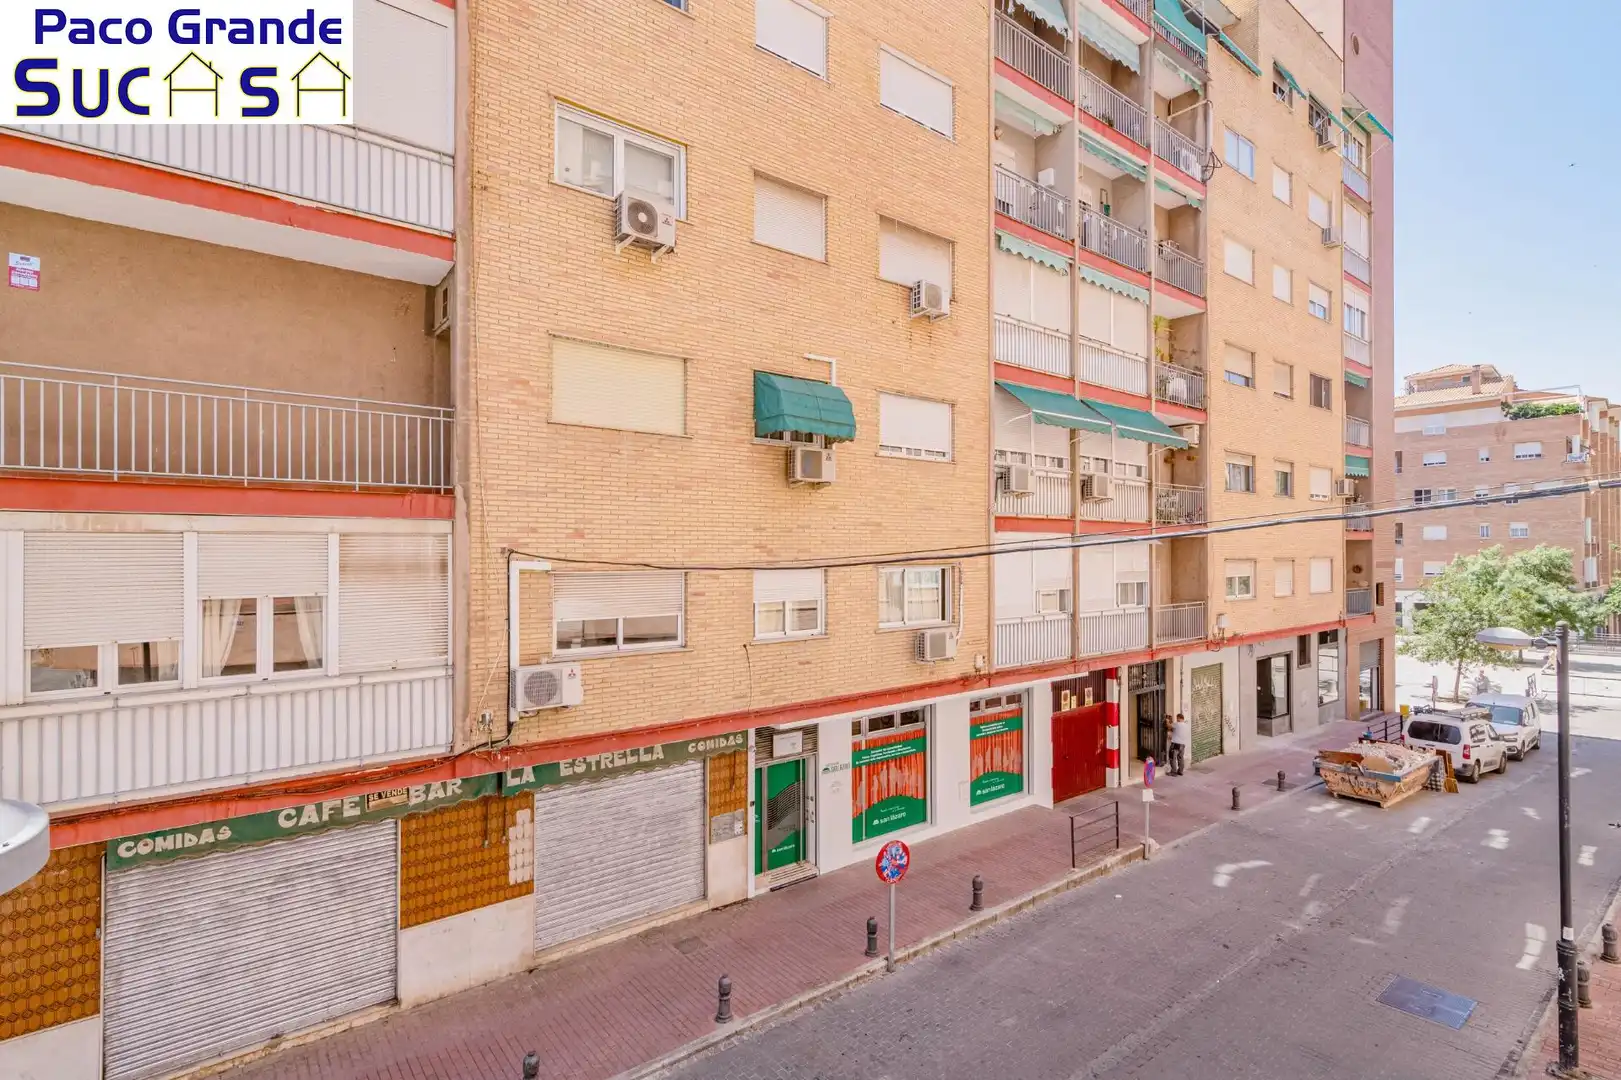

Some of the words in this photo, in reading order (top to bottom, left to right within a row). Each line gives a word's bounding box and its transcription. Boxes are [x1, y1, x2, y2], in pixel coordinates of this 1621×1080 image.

[506, 766, 536, 787] LA
[559, 744, 664, 777] ESTRELLA
[687, 734, 743, 753] COMIDAS
[117, 825, 232, 858] COMIDAS
[277, 797, 361, 828] CAFE
[409, 779, 462, 807] BAR
[368, 793, 379, 802] SE
[382, 787, 407, 798] VENDE
